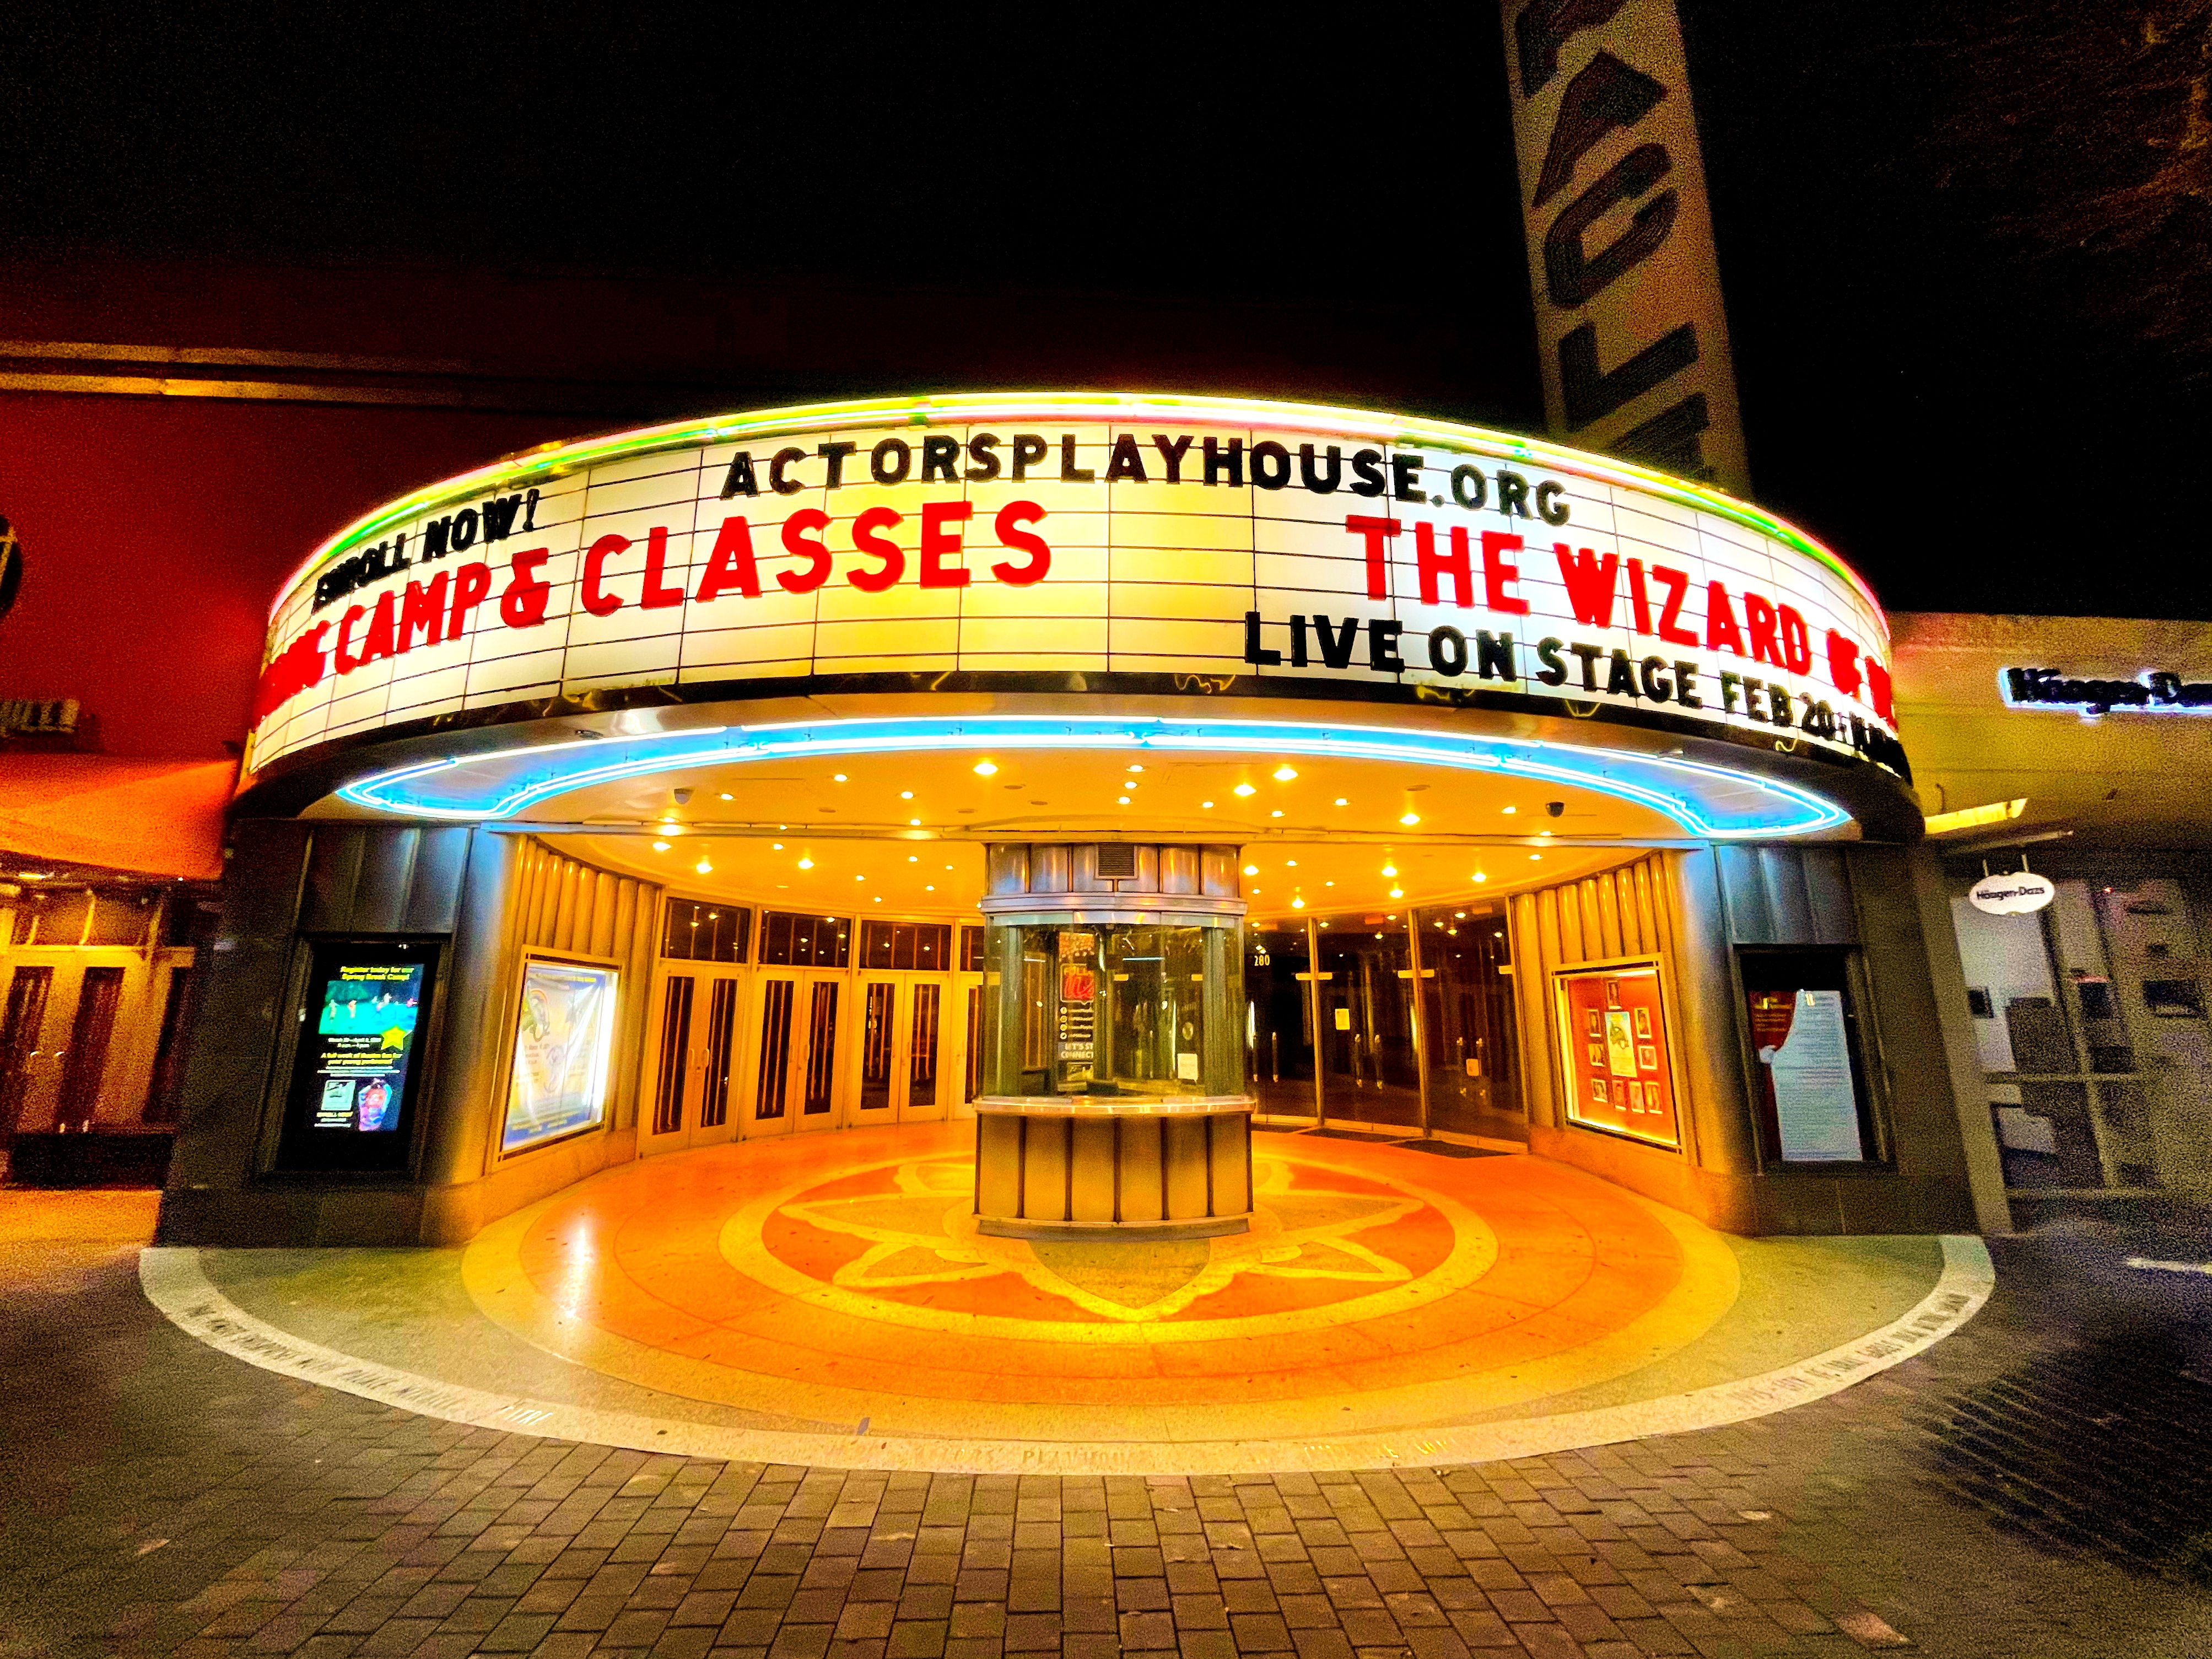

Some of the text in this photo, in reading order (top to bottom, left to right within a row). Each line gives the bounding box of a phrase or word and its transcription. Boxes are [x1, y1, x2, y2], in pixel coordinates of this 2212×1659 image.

[422, 488, 540, 561] NOW!
[719, 433, 1571, 526] ACTORSPLAYHOUSE.ORG
[335, 562, 491, 676] CAMP
[500, 548, 551, 628] &
[581, 500, 1051, 617] CLASSES
[1345, 514, 1531, 617] THE
[1552, 542, 1812, 677] WIZARD
[1245, 611, 1405, 672] LIVE
[1428, 625, 1517, 682] ON
[1535, 636, 1703, 709] STAGE
[1719, 670, 1793, 728] FEB
[1254, 955, 1270, 966] 280
